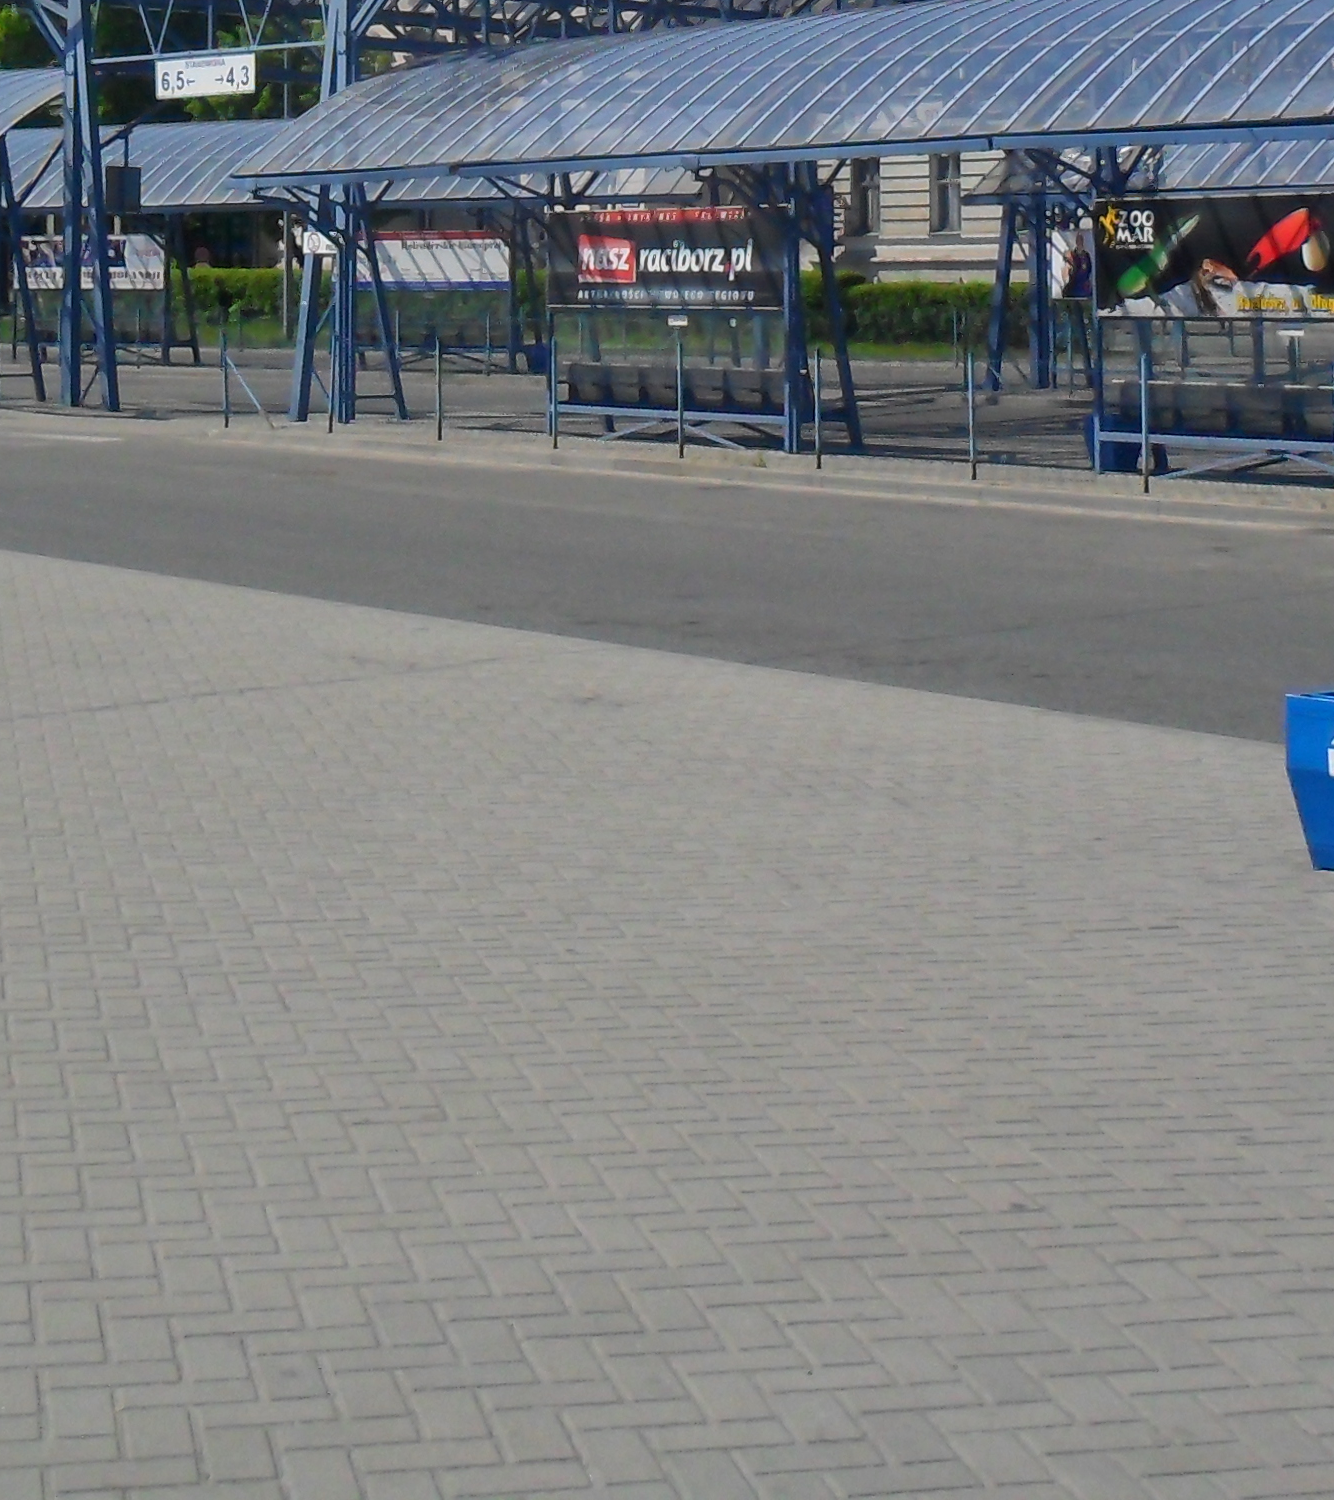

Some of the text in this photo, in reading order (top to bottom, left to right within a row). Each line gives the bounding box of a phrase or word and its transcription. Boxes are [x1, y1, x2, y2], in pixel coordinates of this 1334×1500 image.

[161, 65, 250, 95] 6,5 4,3
[1117, 210, 1155, 227] ZOO
[1116, 227, 1155, 243] MAR
[581, 247, 630, 271] nasz
